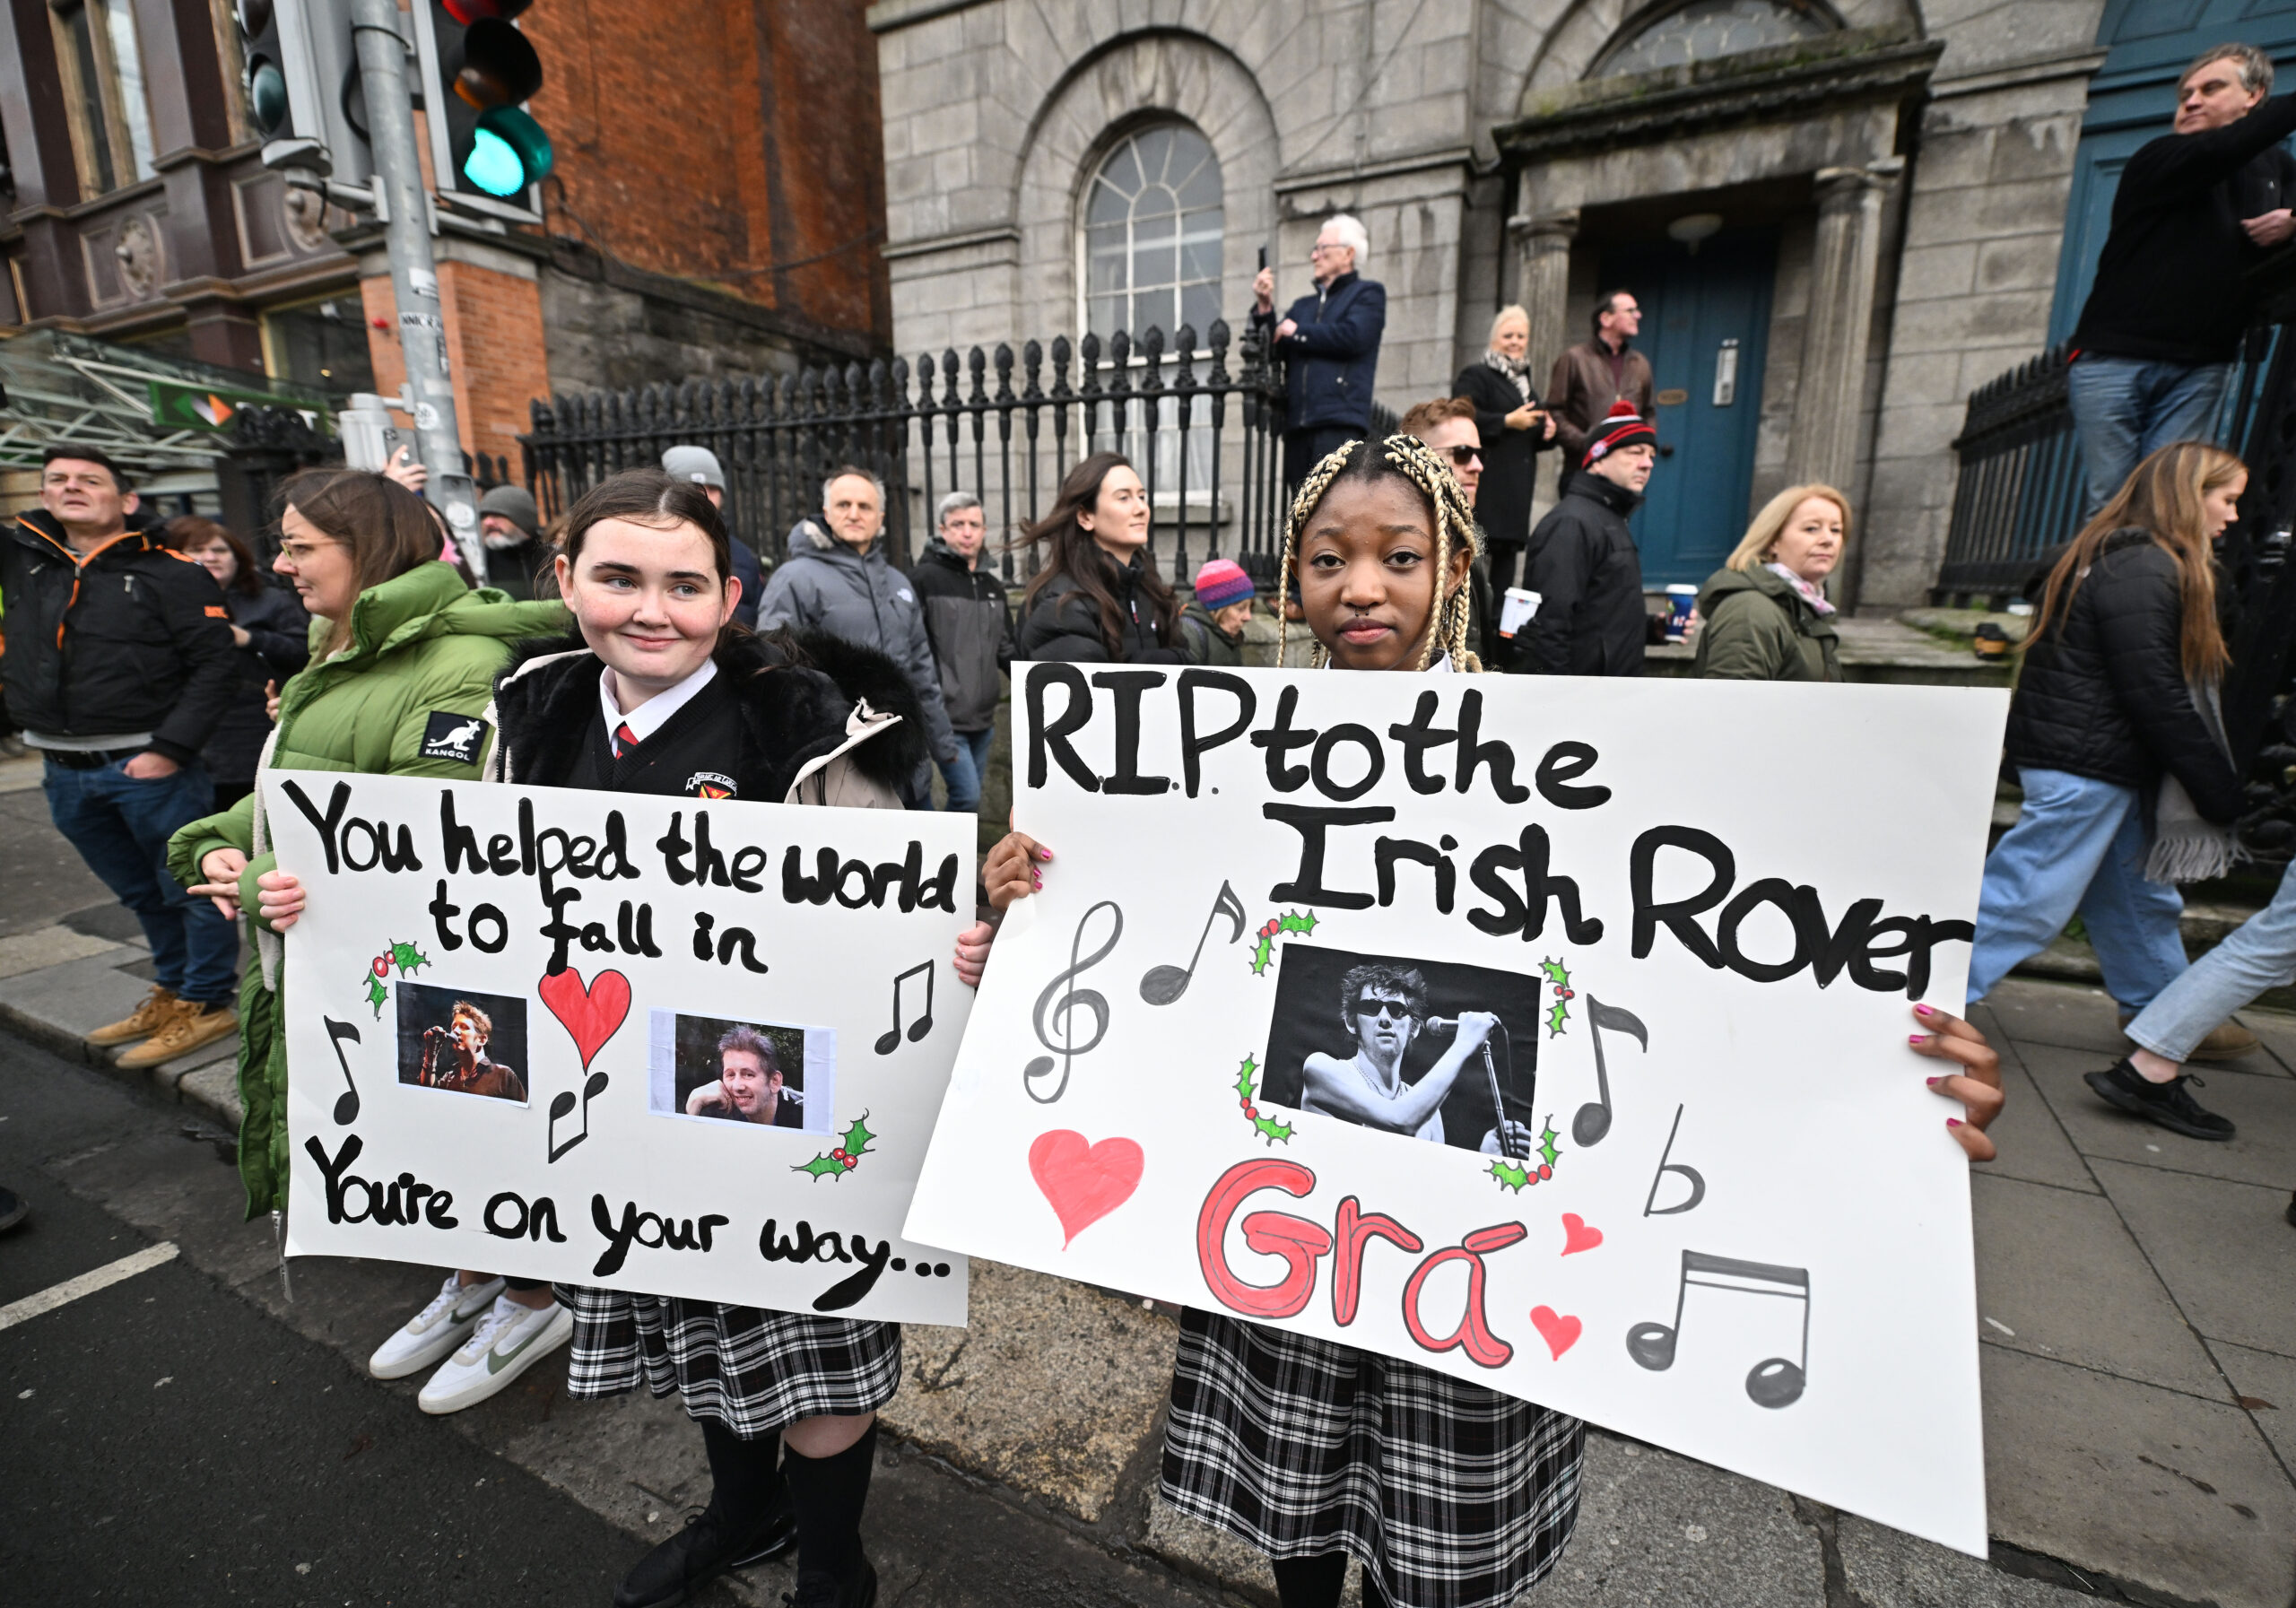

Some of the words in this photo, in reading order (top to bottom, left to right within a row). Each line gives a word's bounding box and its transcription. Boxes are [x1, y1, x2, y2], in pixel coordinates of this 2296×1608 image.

[425, 748, 470, 761] KANGOL
[1250, 684, 1386, 803] to
[1388, 688, 1612, 810] the
[281, 779, 422, 875] You
[440, 789, 640, 908] helped
[656, 810, 767, 893] the
[781, 840, 959, 914] world
[1262, 803, 1605, 945] Irish
[1630, 824, 1975, 1002] Rover
[428, 879, 509, 954] to
[539, 887, 663, 978] fall
[691, 910, 769, 974] in
[483, 1191, 568, 1245] on
[591, 1193, 730, 1278] your
[759, 1218, 951, 1312] way...
[1196, 1158, 1527, 1369] Grá
